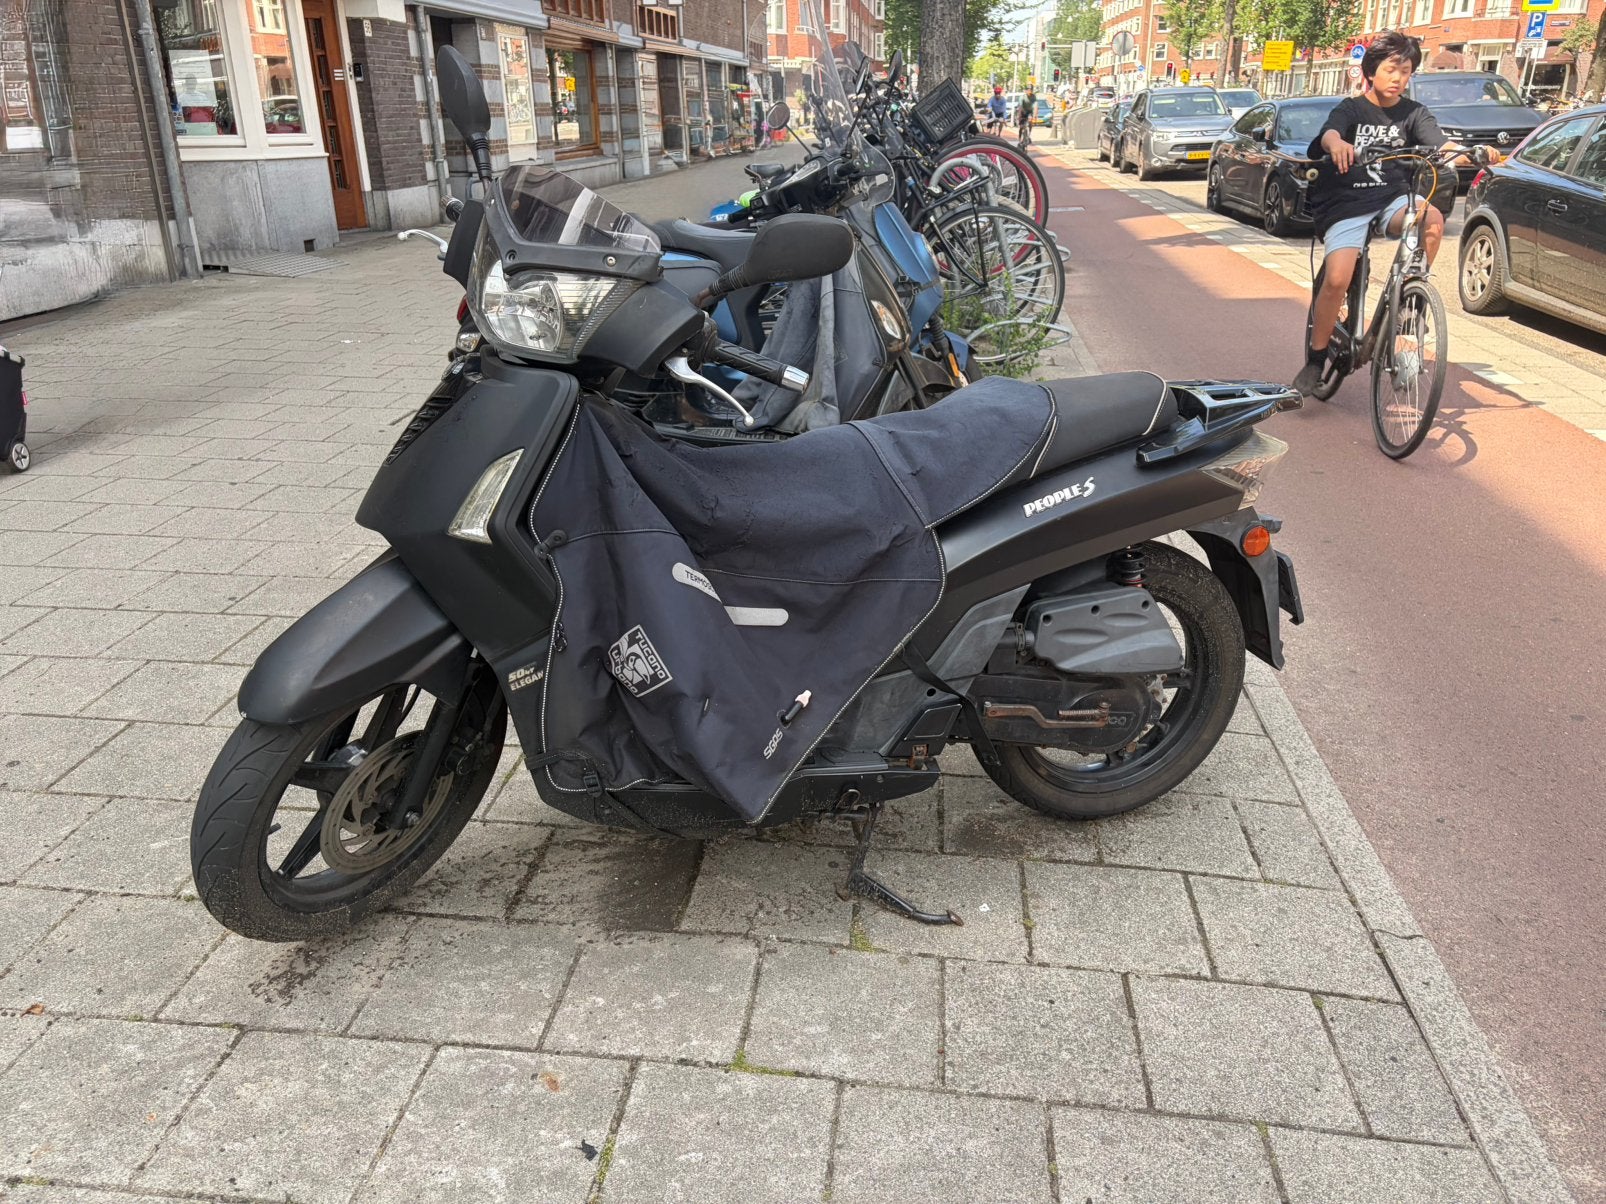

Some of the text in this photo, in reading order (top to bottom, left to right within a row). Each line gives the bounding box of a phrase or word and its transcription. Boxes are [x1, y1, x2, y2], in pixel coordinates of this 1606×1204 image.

[1531, 13, 1543, 27] P
[1356, 124, 1400, 137] LOVE &
[635, 631, 666, 679] Tucano
